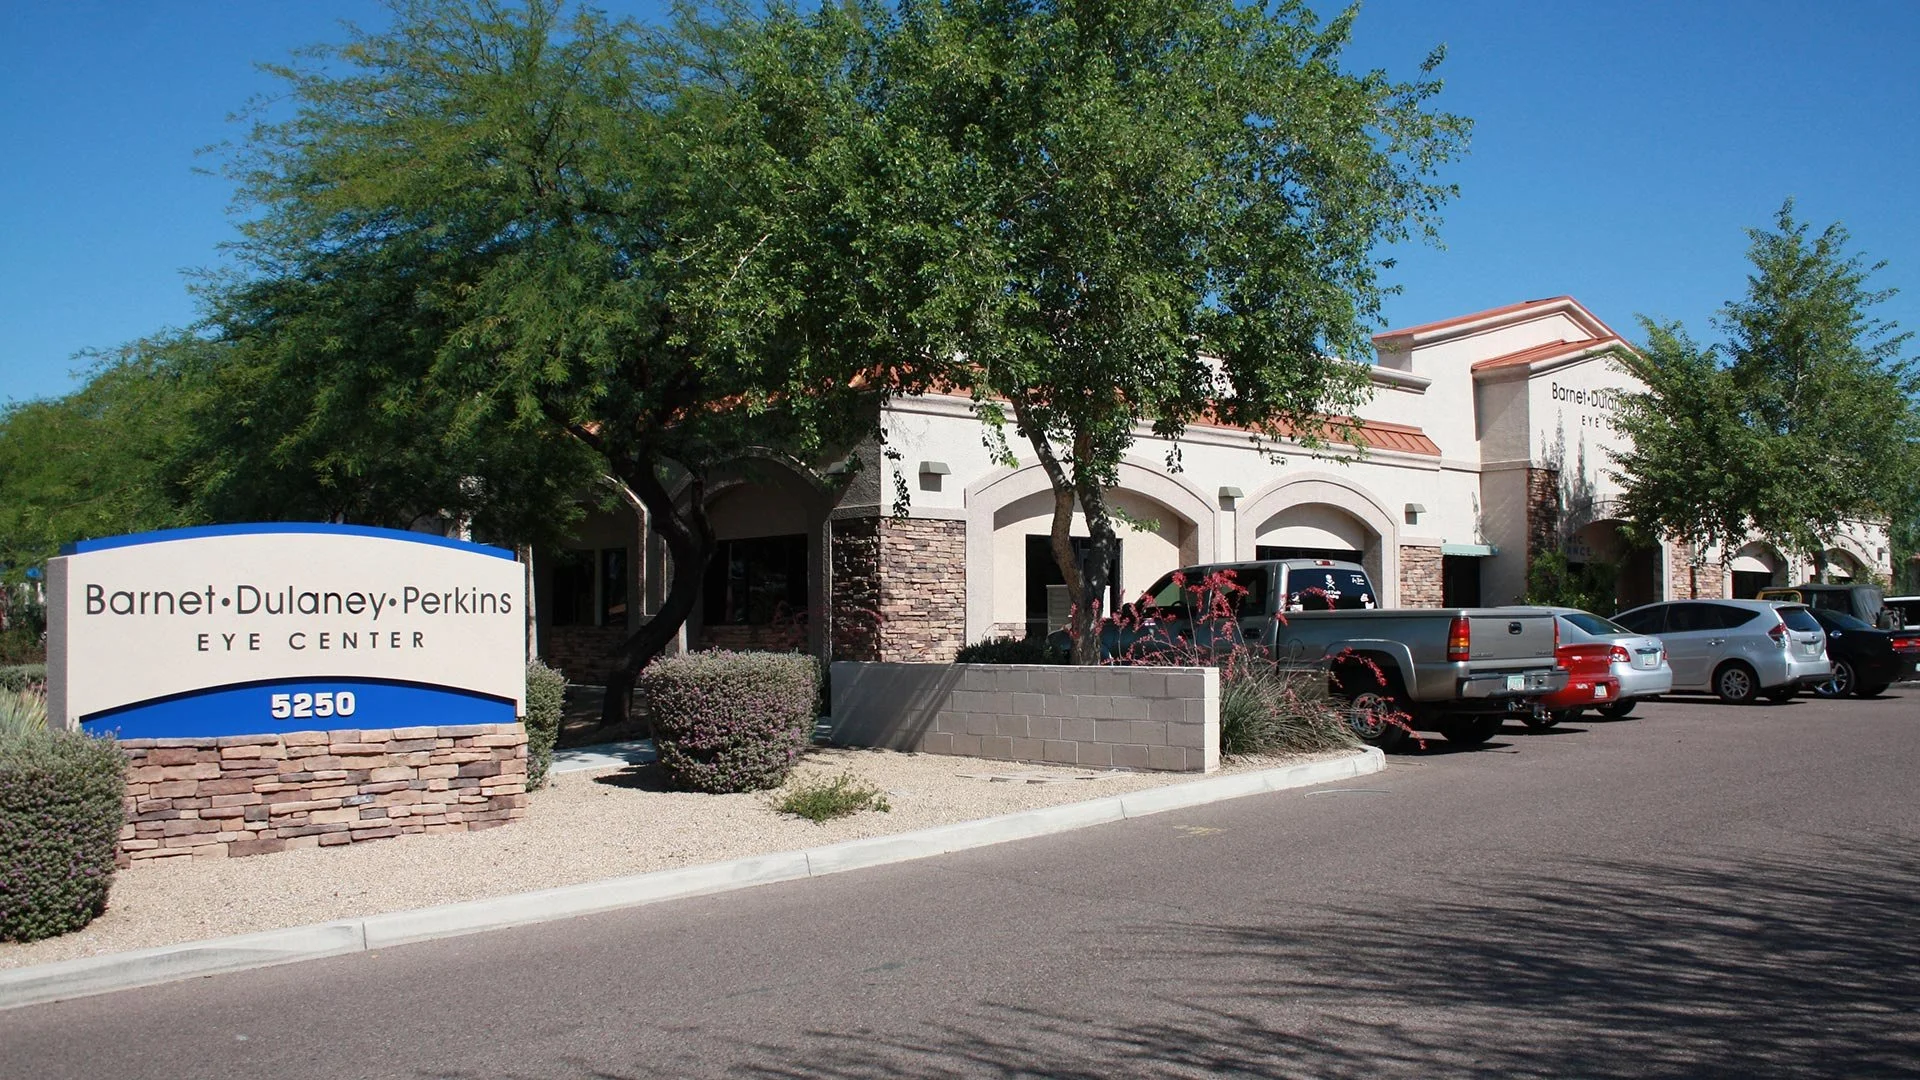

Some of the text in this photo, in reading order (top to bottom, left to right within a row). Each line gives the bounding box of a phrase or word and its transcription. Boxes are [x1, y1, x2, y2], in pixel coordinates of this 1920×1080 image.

[1581, 415, 1599, 428] EYE
[197, 631, 425, 652] EYE CENTER
[271, 691, 356, 718] 5250
